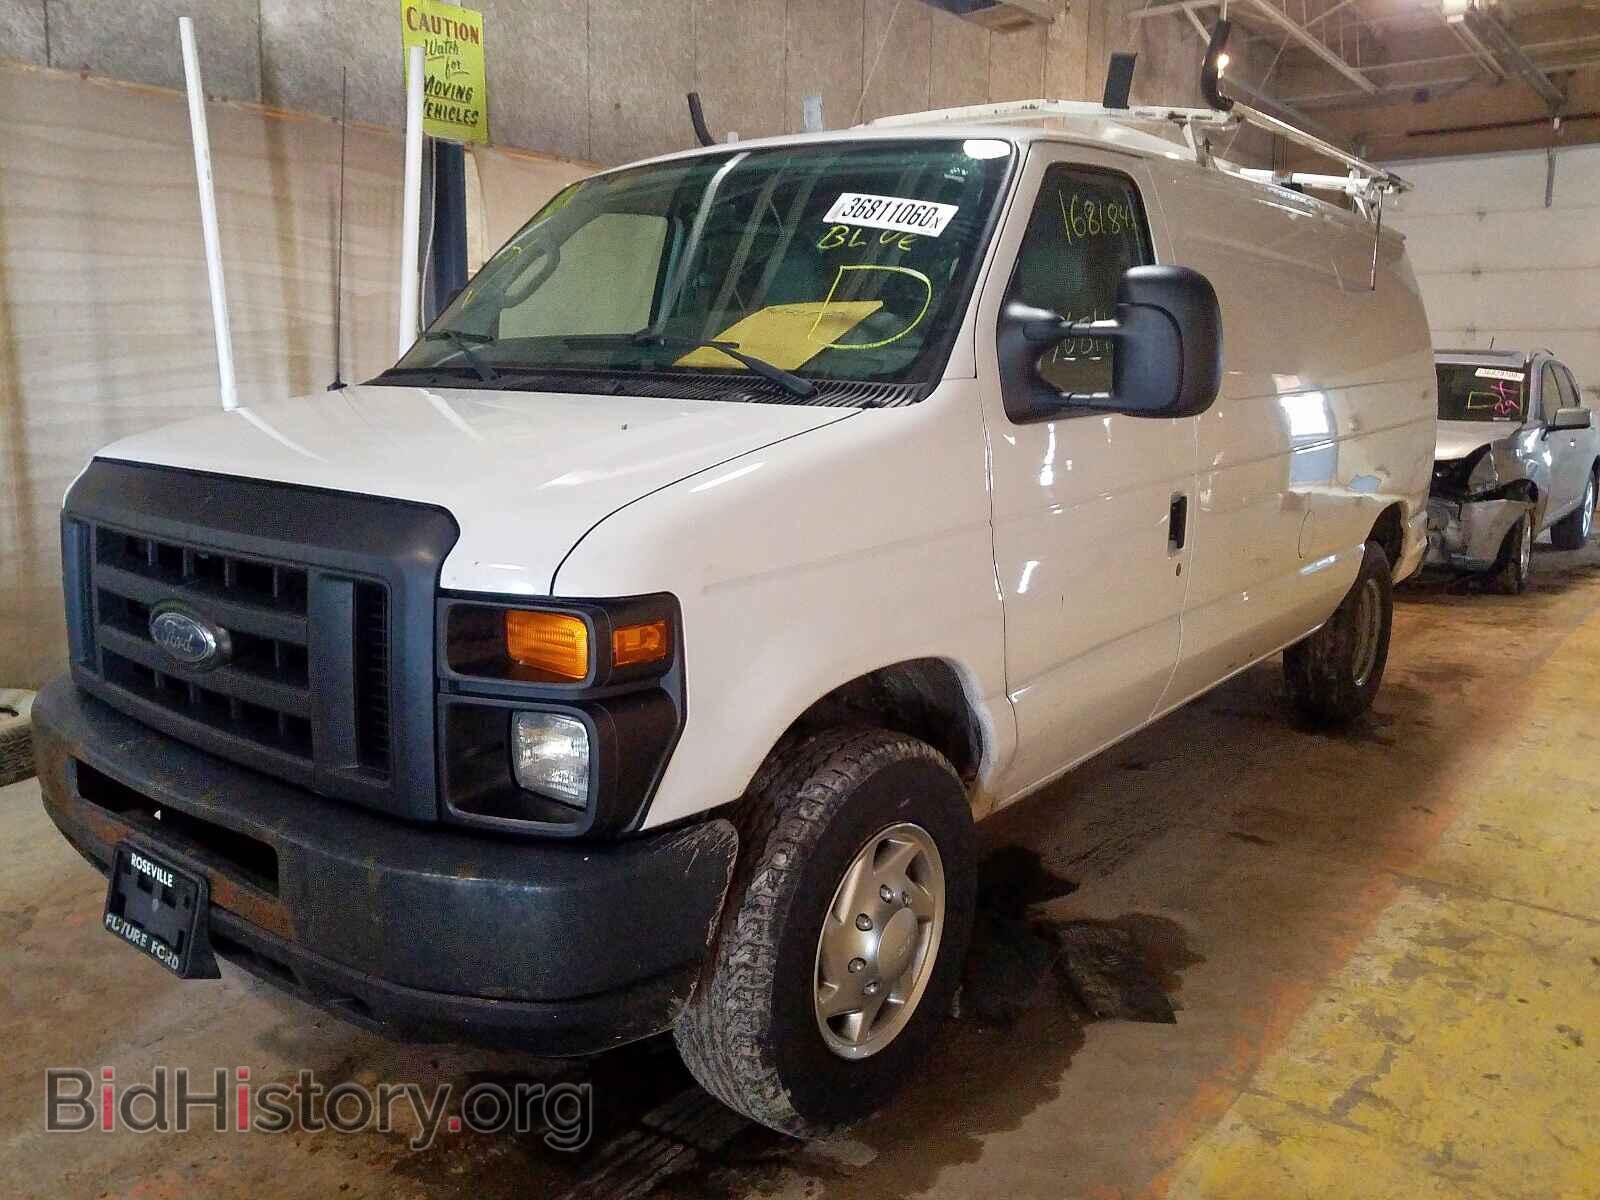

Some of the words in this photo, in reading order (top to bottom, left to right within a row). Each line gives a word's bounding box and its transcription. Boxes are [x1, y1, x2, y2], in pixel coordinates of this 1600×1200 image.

[406, 6, 480, 45] CAUTION
[445, 57, 462, 80] for
[130, 852, 174, 888] ROSEVILLE
